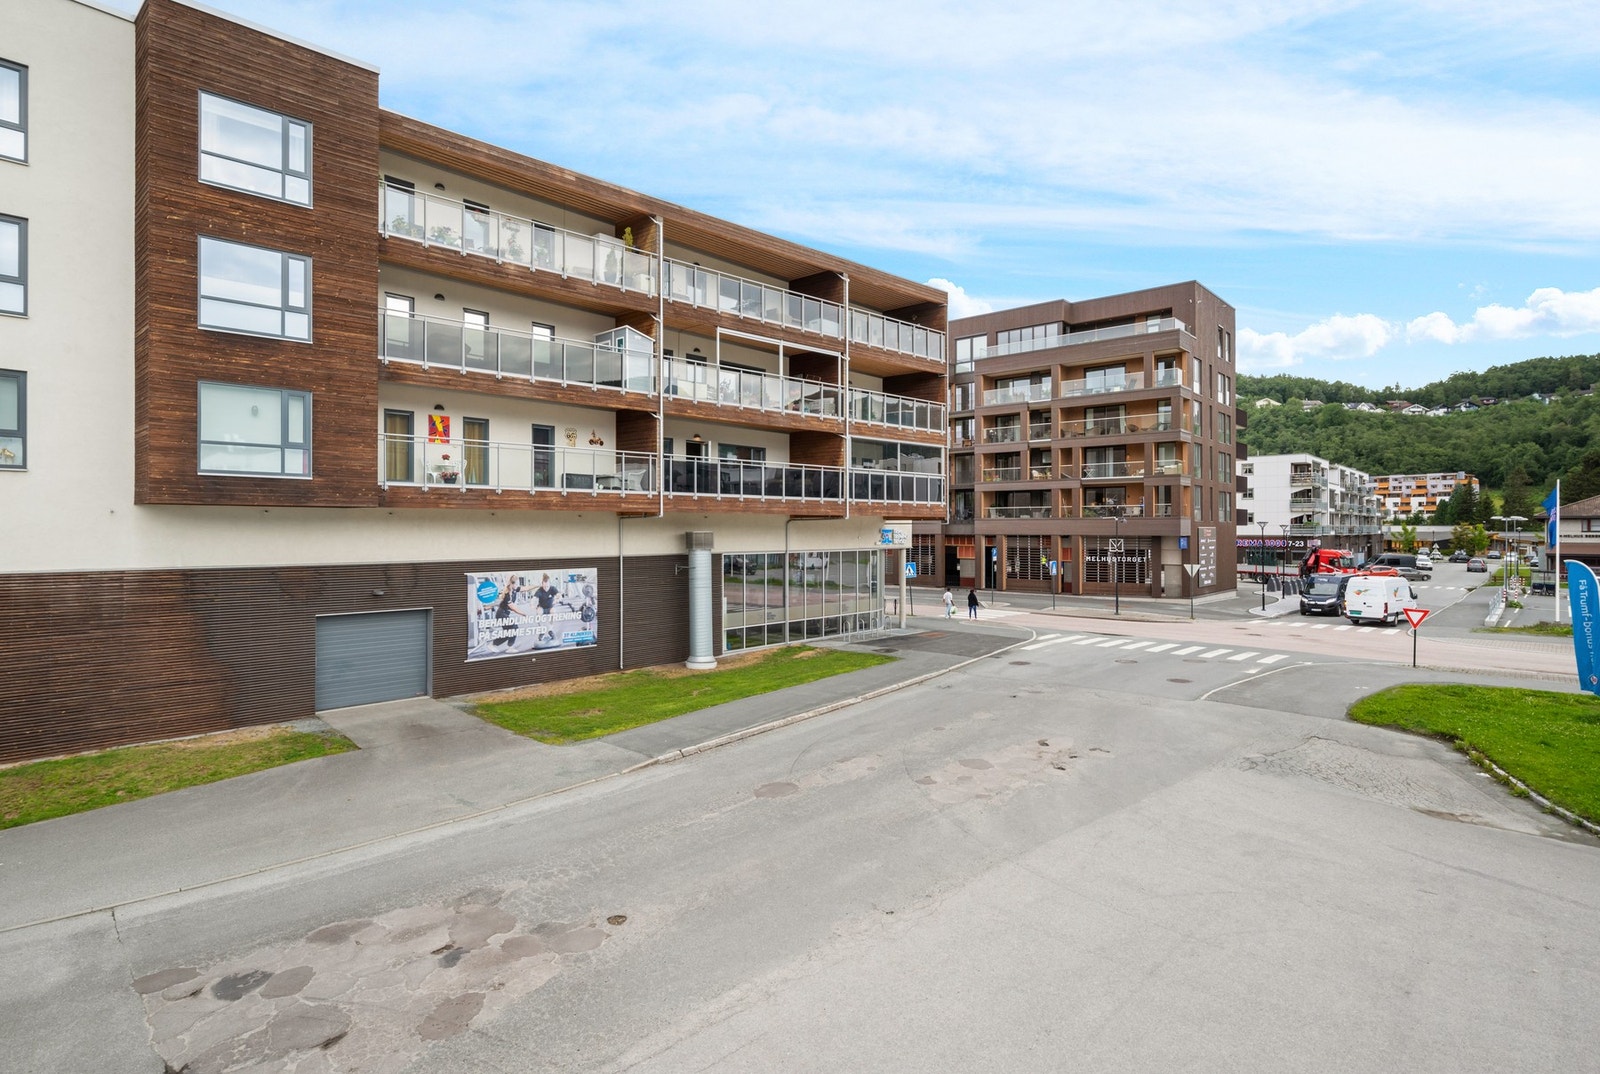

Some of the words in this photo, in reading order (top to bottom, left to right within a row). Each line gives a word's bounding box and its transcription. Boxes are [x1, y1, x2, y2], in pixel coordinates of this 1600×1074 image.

[1265, 539, 1287, 548] 1000
[1086, 555, 1147, 563] MELHUSTORGET
[1578, 579, 1588, 591] Få
[478, 614, 534, 629] BEHANDLING
[535, 612, 548, 623] OG
[548, 611, 582, 622] TRENING
[490, 627, 525, 639] SAMME
[525, 626, 548, 637] STED
